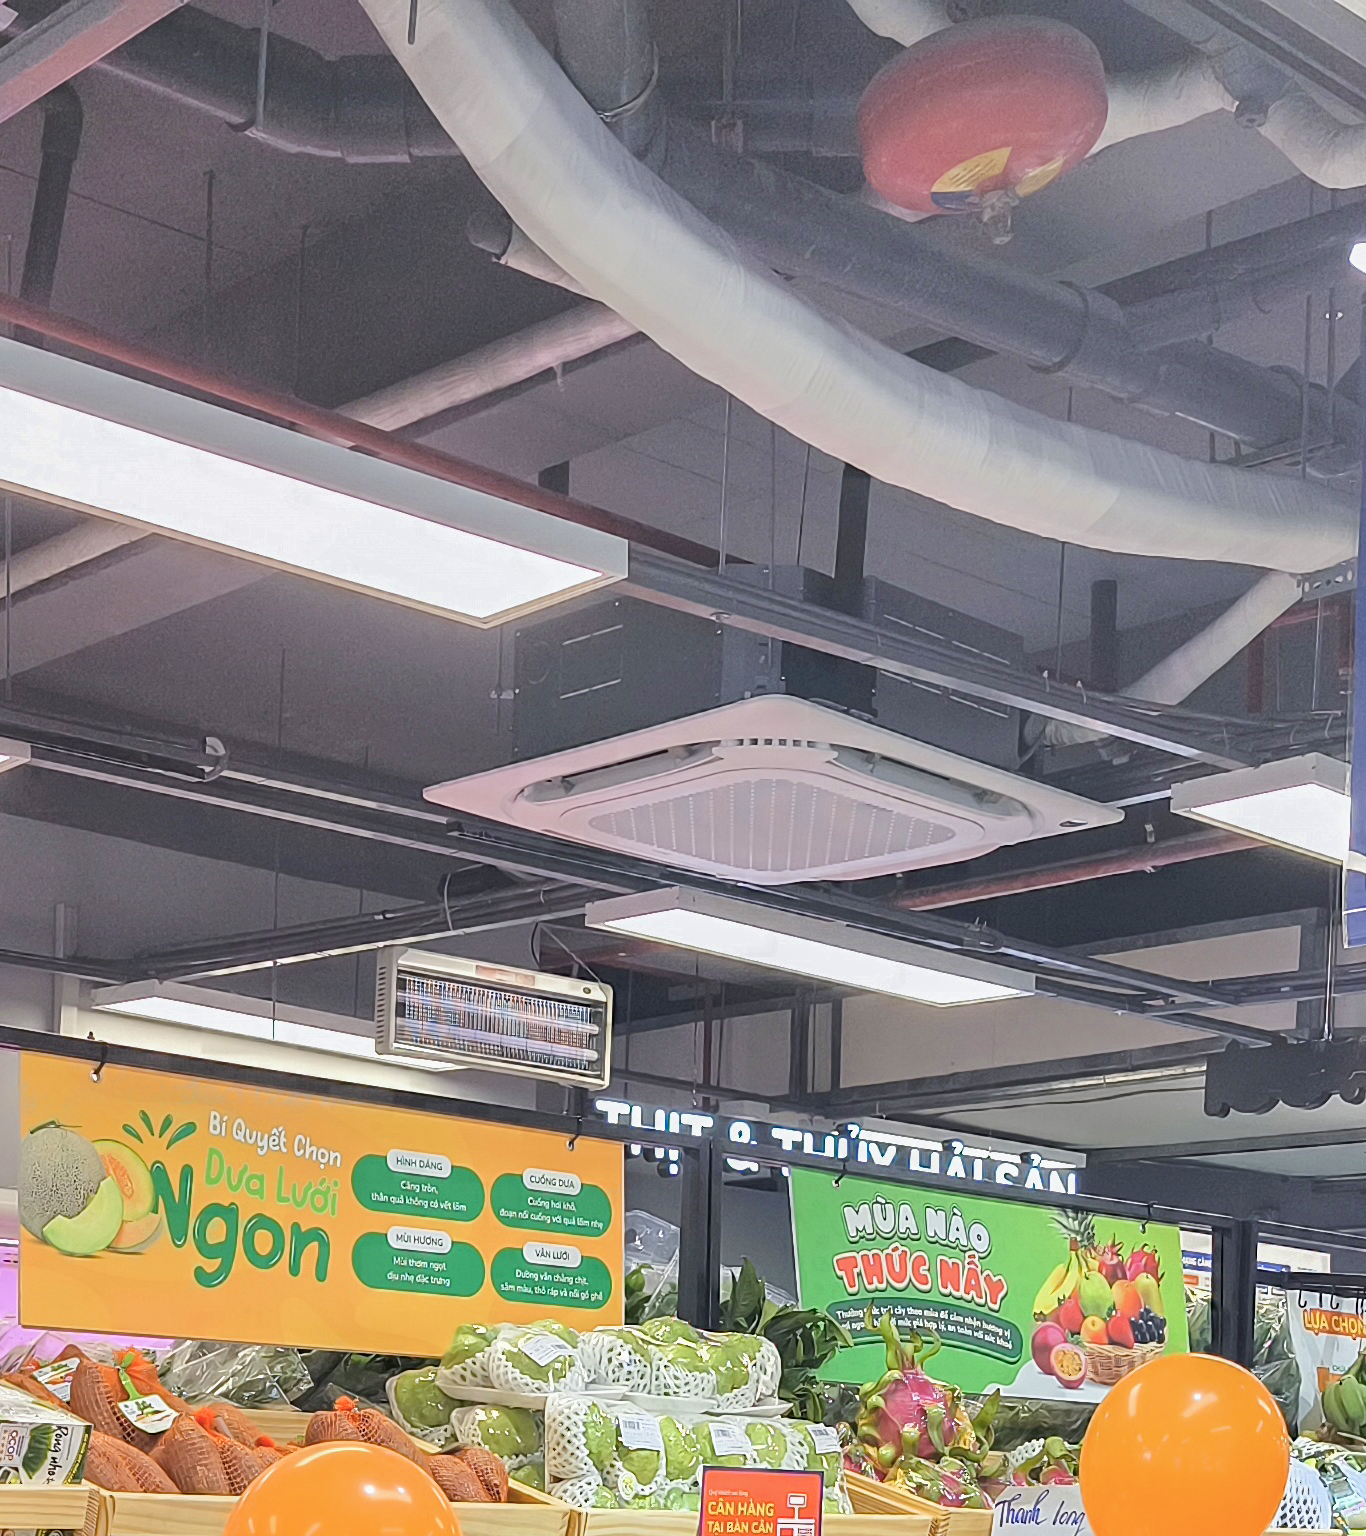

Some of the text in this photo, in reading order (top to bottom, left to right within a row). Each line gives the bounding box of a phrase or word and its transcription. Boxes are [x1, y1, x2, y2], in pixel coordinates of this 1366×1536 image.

[209, 1110, 342, 1169] Bí Quyết Chọn
[396, 1155, 443, 1171] HÌNH DÁNG
[204, 1147, 340, 1218] Dưa Lưới
[150, 1159, 331, 1289] Ngon
[396, 1231, 412, 1243] MÙI
[841, 1193, 992, 1258] MÙA NÀO
[833, 1242, 932, 1295] THỨC
[1302, 1311, 1329, 1336] LỰA
[707, 1498, 775, 1517] CÂN HÀNG
[995, 1489, 1049, 1527] Thanh
[707, 1518, 773, 1536] TẠI BÀN CÂN
